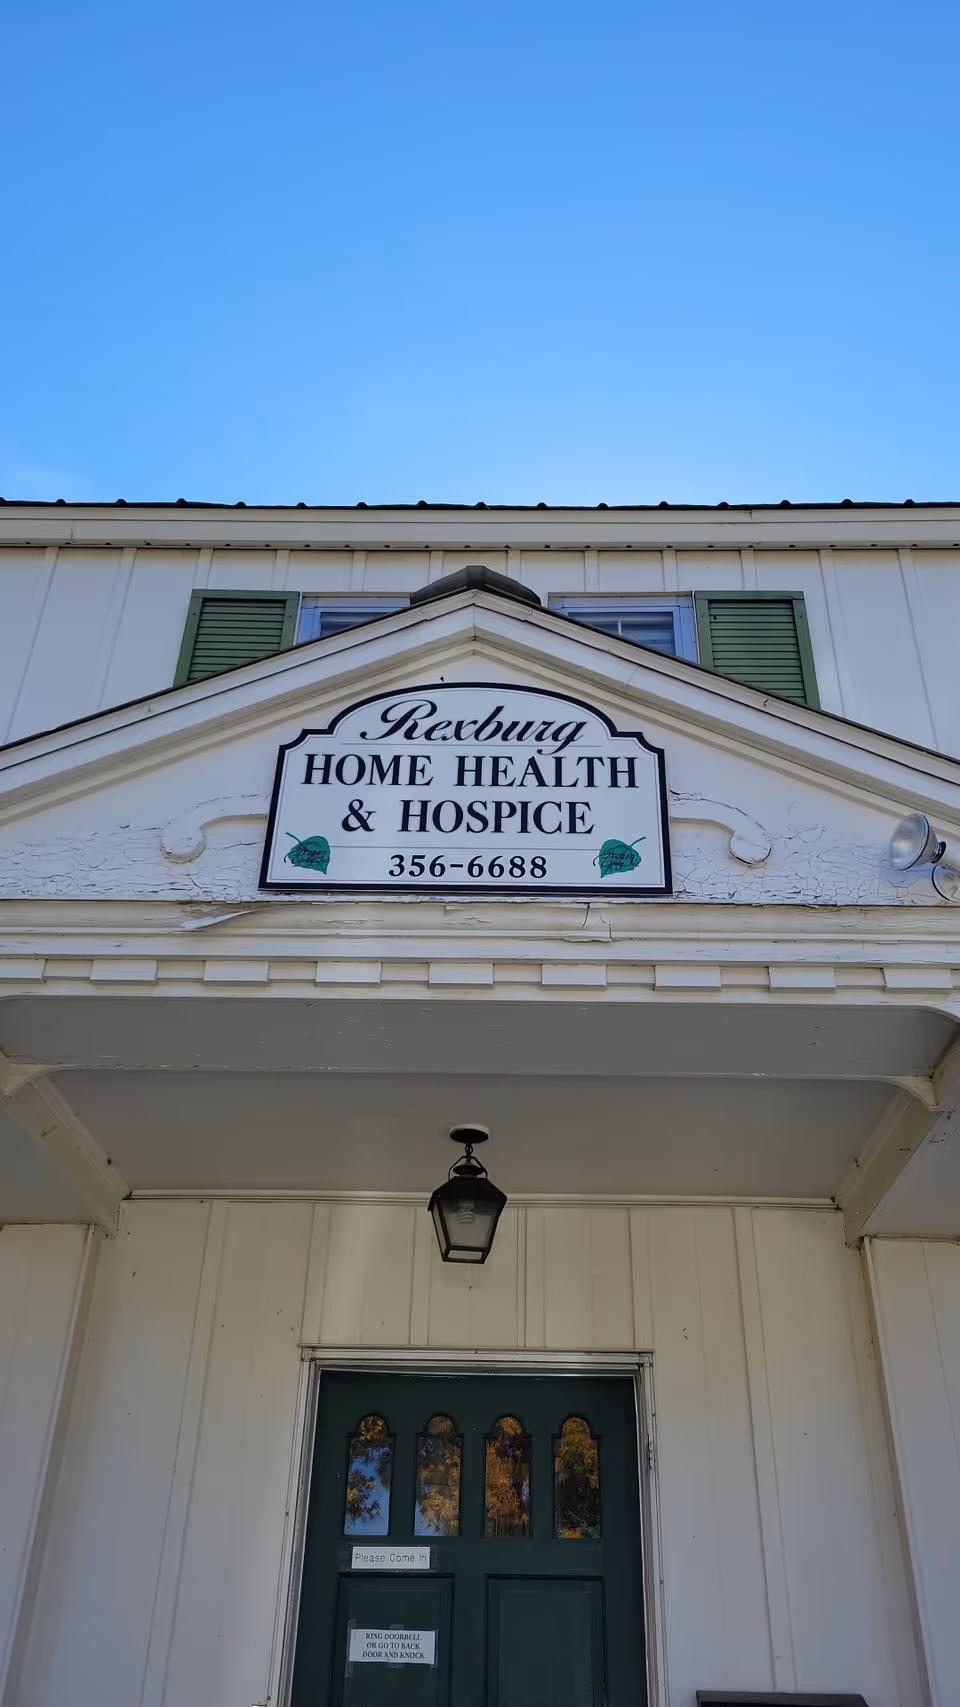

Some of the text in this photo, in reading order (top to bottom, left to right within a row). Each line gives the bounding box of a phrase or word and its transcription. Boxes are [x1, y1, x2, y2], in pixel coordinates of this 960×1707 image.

[359, 699, 588, 755] Rexburg
[302, 754, 640, 788] HOME HEALTH
[341, 799, 595, 834] & HOSPICE
[389, 855, 548, 878] 356-6688
[355, 1553, 427, 1563] Please Come In
[365, 1632, 422, 1641] RING DOORBELL
[390, 1642, 400, 1650] TO
[362, 1650, 425, 1660] DOOR AND KNOCK
